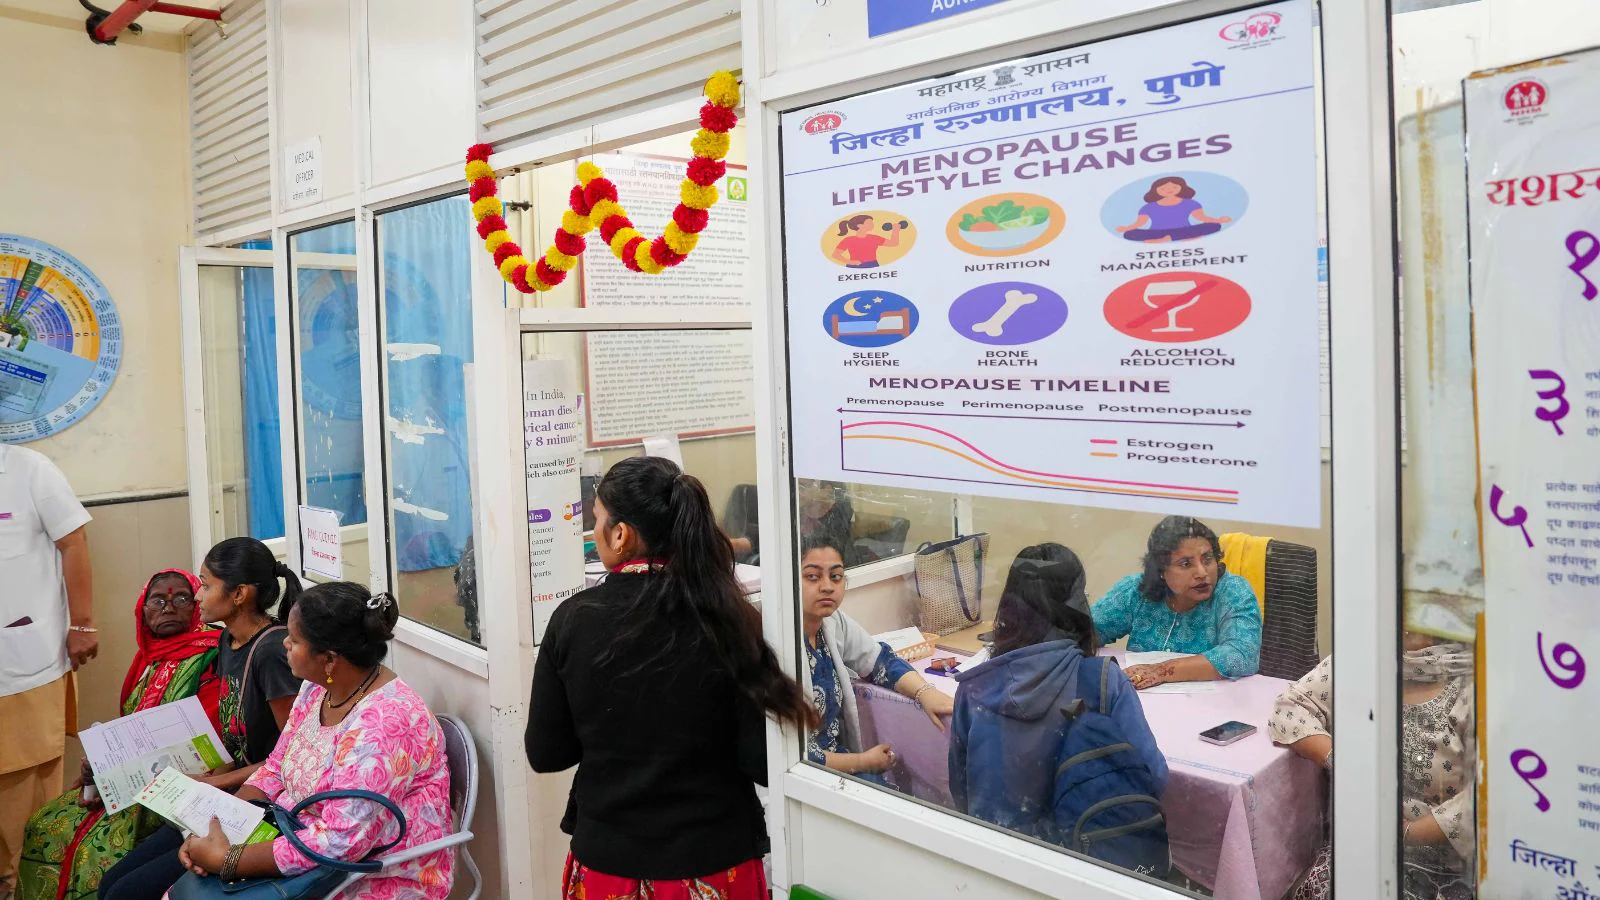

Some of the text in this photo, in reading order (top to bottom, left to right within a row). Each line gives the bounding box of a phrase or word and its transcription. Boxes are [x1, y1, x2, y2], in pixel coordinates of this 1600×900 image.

[917, 75, 987, 97] महाराष्ट्र
[1022, 52, 1091, 77] शासन
[906, 99, 980, 121] सार्वजनिक
[987, 87, 1044, 104] आरोग्य
[1051, 74, 1107, 93] विभाग
[829, 121, 924, 155] जिल्हा
[1144, 61, 1226, 105] पुणे
[881, 121, 1138, 180] MENOPAUSE
[831, 132, 1234, 206] LIFESTYLE CHANGES
[1485, 167, 1600, 207] यशस्
[1135, 247, 1205, 260] STRESS
[964, 259, 1050, 272] NUTRITION
[1565, 230, 1600, 301] १
[837, 269, 898, 282] EXERCISE
[852, 351, 889, 359] SLEEP
[985, 350, 1029, 358] BONE
[1130, 349, 1227, 357] ALCOHOL
[843, 359, 900, 367] HYGIENE
[977, 359, 1038, 367] HEALTH
[1120, 357, 1235, 366] REDUCTION
[869, 377, 1170, 394] MENOPAUSE TIMELINE
[846, 397, 1252, 416] Premenopause Perimenopause Postmenopause
[1527, 369, 1570, 435] ३
[536, 437, 543, 446] 8
[1126, 438, 1214, 451] Estrogen
[529, 459, 556, 469] caused
[559, 458, 565, 466] by
[1126, 452, 1257, 468] Progesterone
[542, 469, 557, 478] also
[1490, 484, 1534, 548] ५
[556, 589, 569, 598] can
[1537, 631, 1586, 689] ७
[1510, 749, 1550, 812] ९
[1509, 839, 1577, 877] जिल्हा
